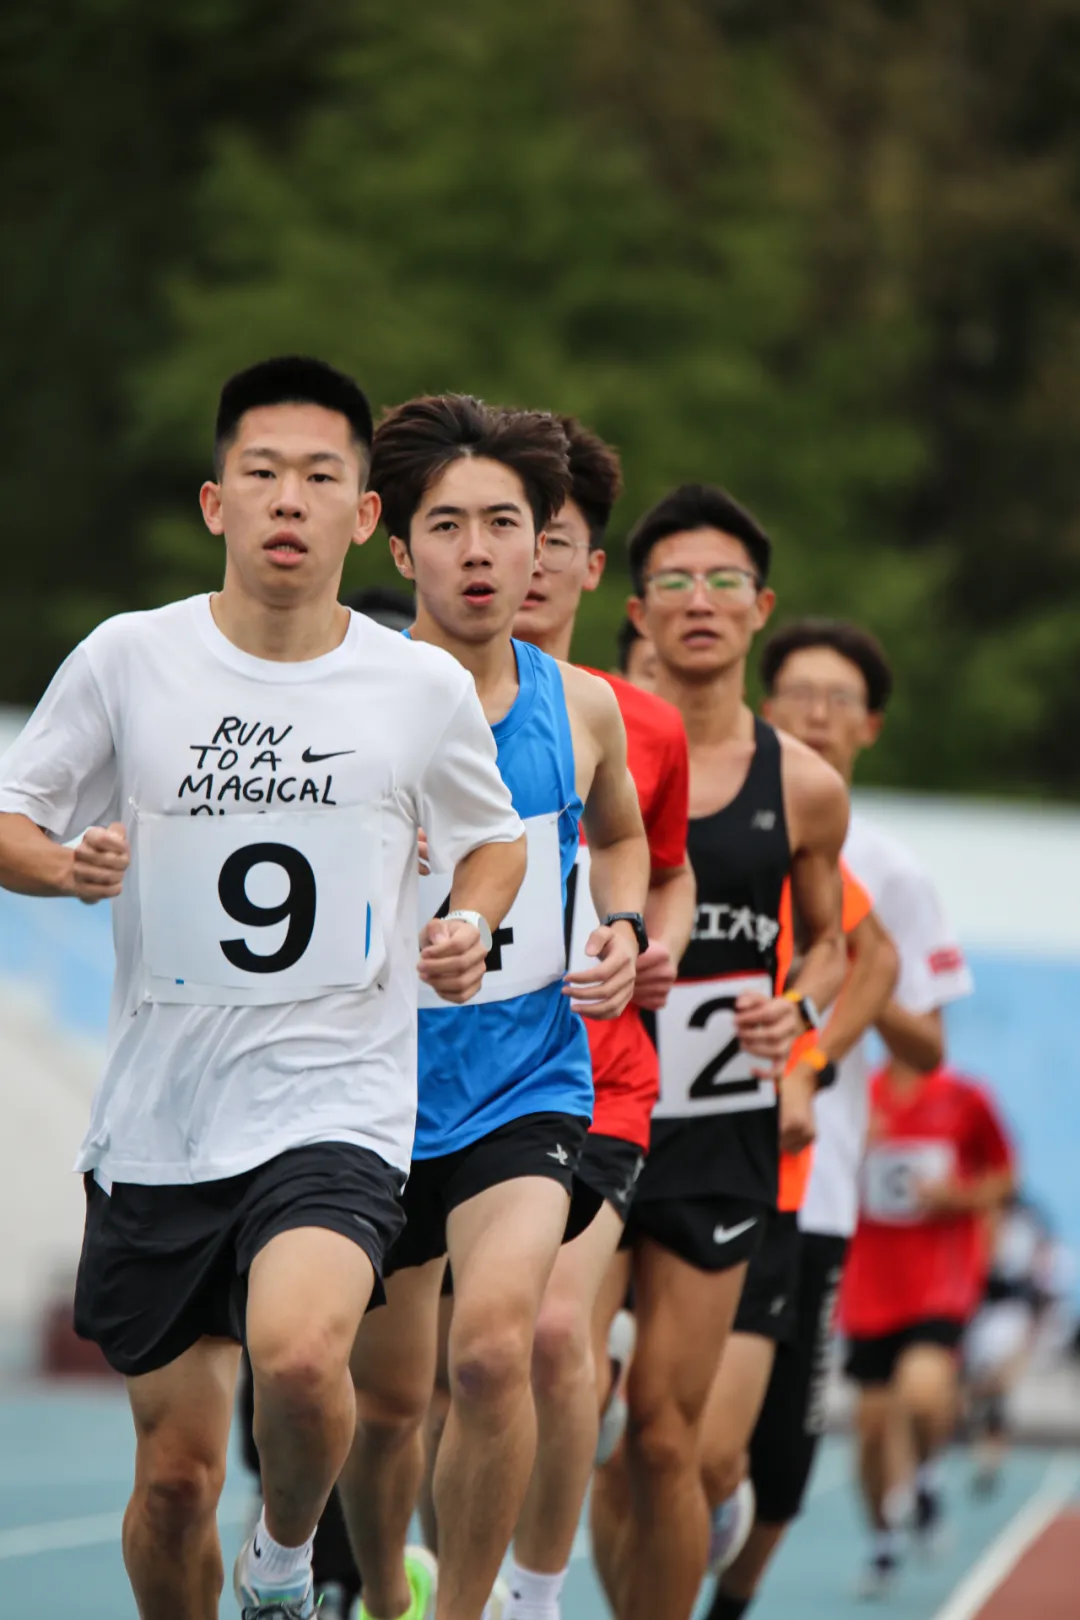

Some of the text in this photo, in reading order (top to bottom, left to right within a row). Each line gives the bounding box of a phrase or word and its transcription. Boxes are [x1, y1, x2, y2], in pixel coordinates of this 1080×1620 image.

[211, 716, 293, 746] RUN
[189, 745, 283, 772] TO A
[177, 773, 337, 806] MAGICAL
[217, 842, 317, 974] 9
[687, 996, 762, 1101] 2
